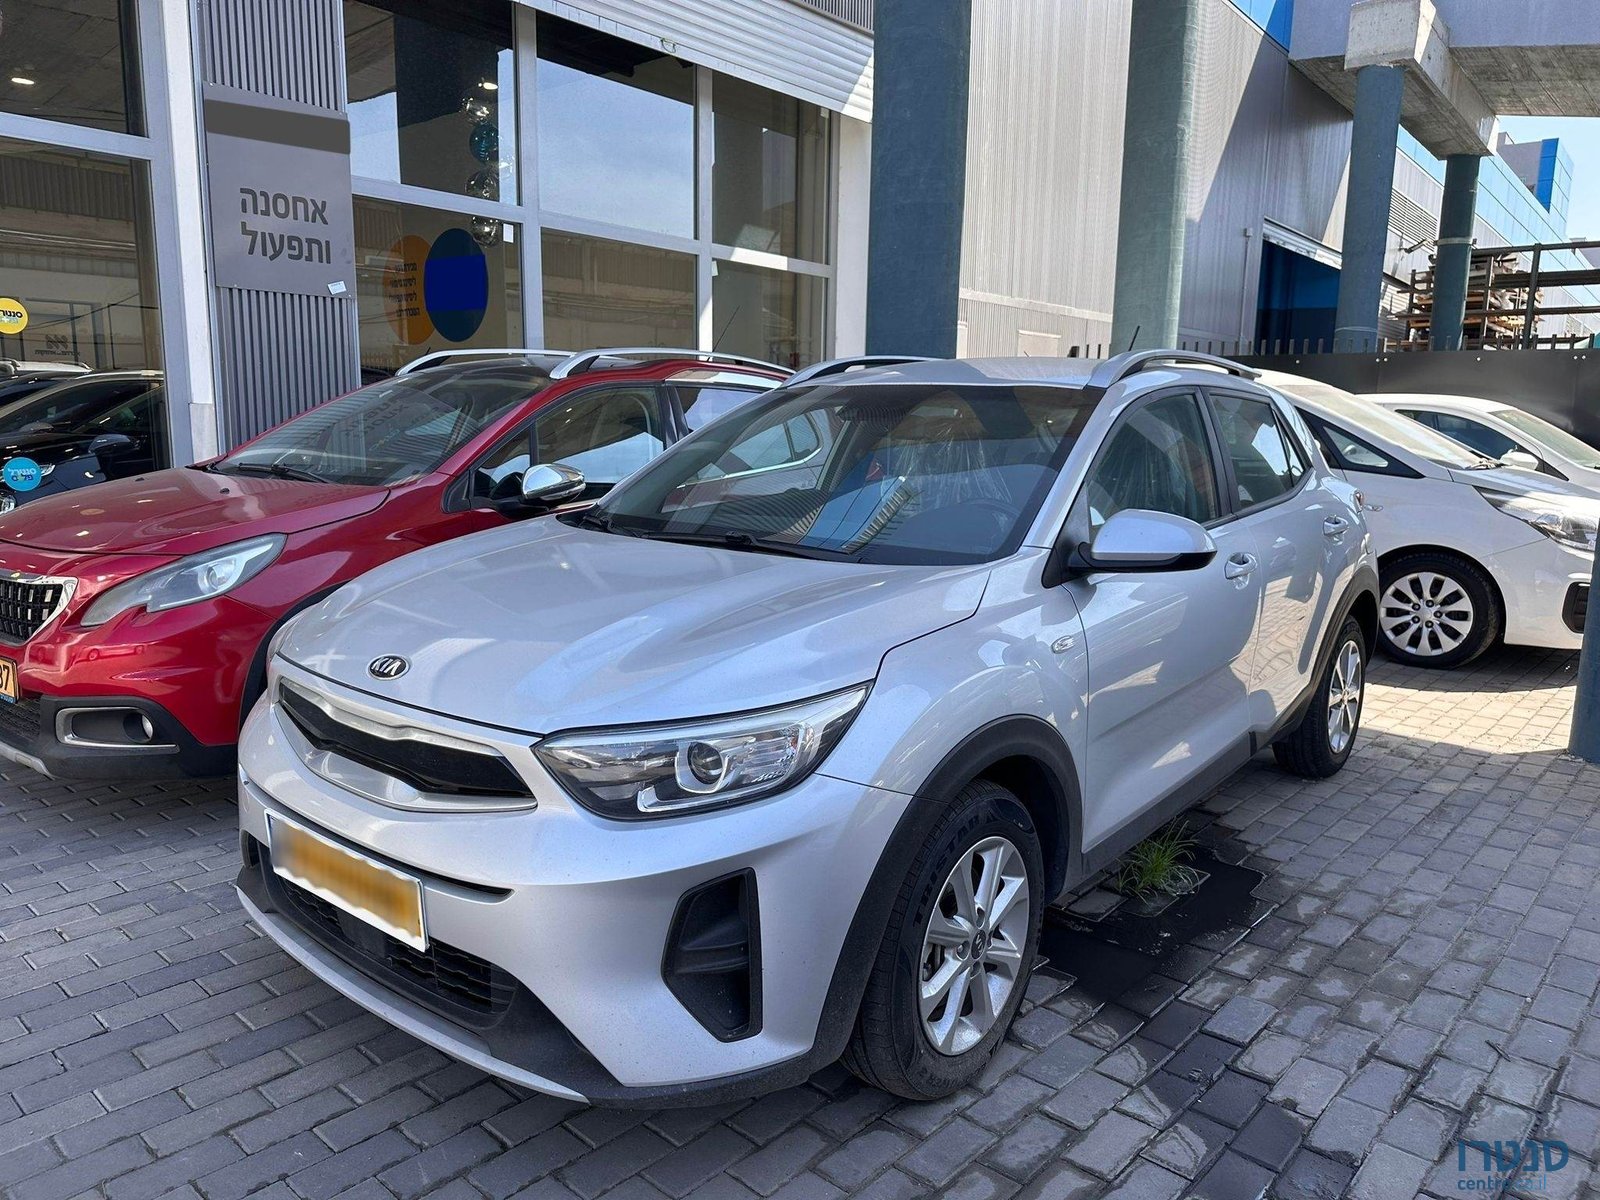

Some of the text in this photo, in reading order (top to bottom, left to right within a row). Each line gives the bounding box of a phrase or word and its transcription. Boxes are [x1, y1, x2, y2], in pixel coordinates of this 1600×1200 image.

[239, 187, 329, 225] אחסנה
[240, 221, 331, 264] ותפעול
[371, 657, 402, 676] KIA
